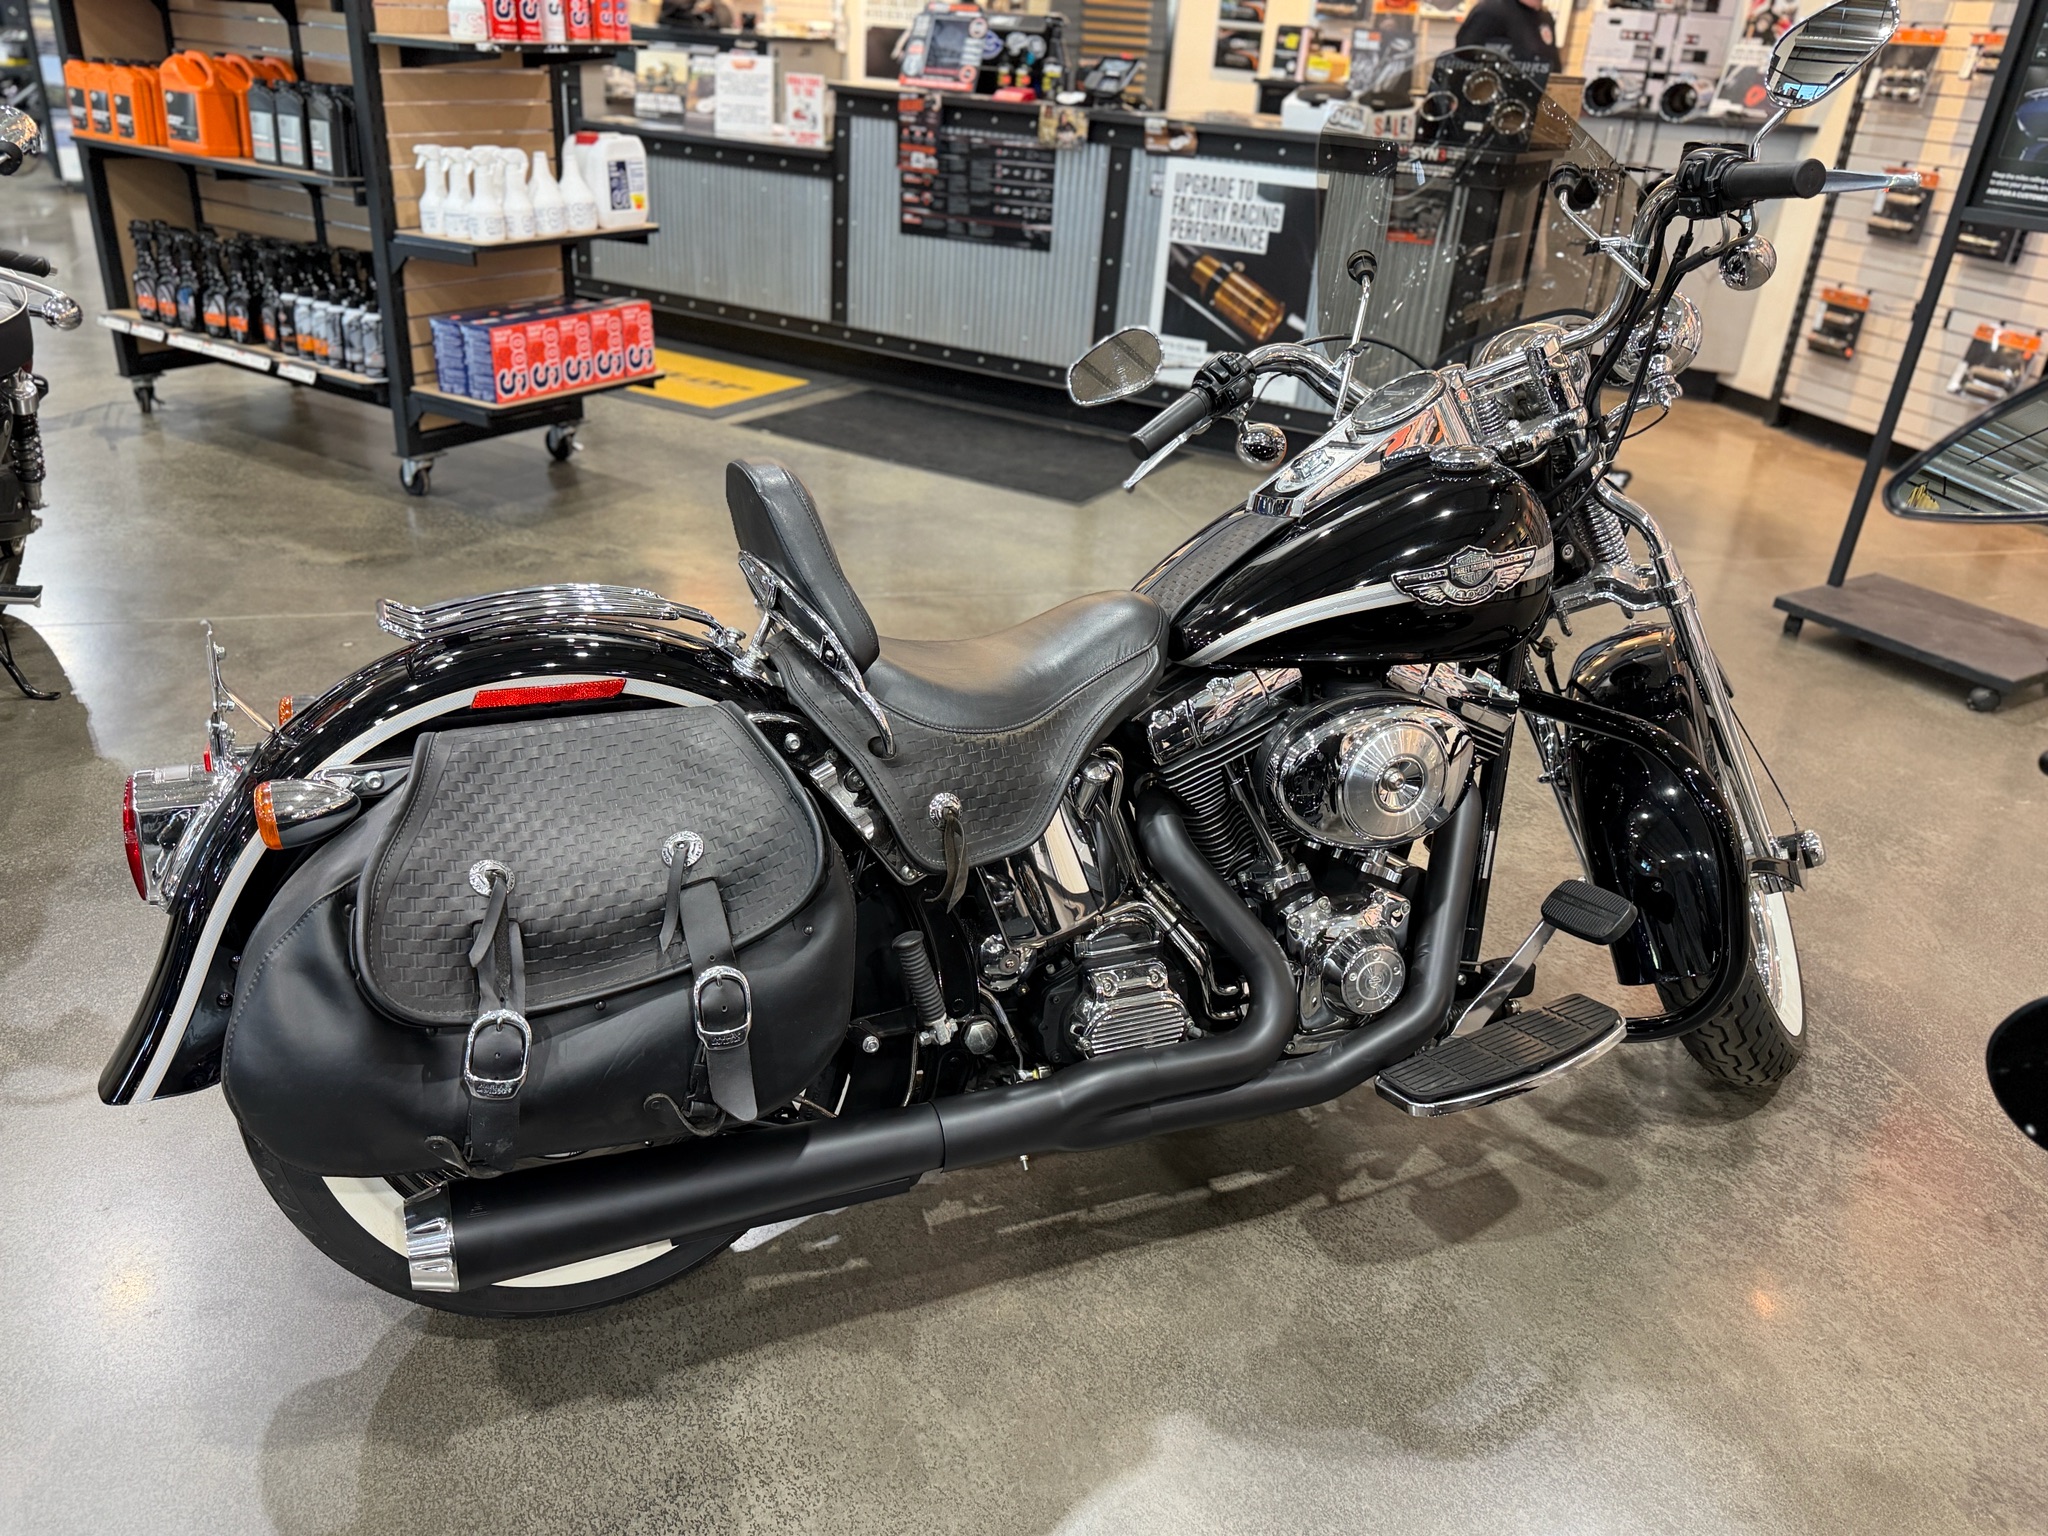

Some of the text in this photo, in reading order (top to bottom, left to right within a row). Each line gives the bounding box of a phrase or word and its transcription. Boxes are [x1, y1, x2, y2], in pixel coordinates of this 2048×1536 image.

[1174, 172, 1255, 201] UPGRADE TO
[1172, 195, 1281, 229] FACTORY RACING
[1170, 218, 1266, 250] PERFORMANCE
